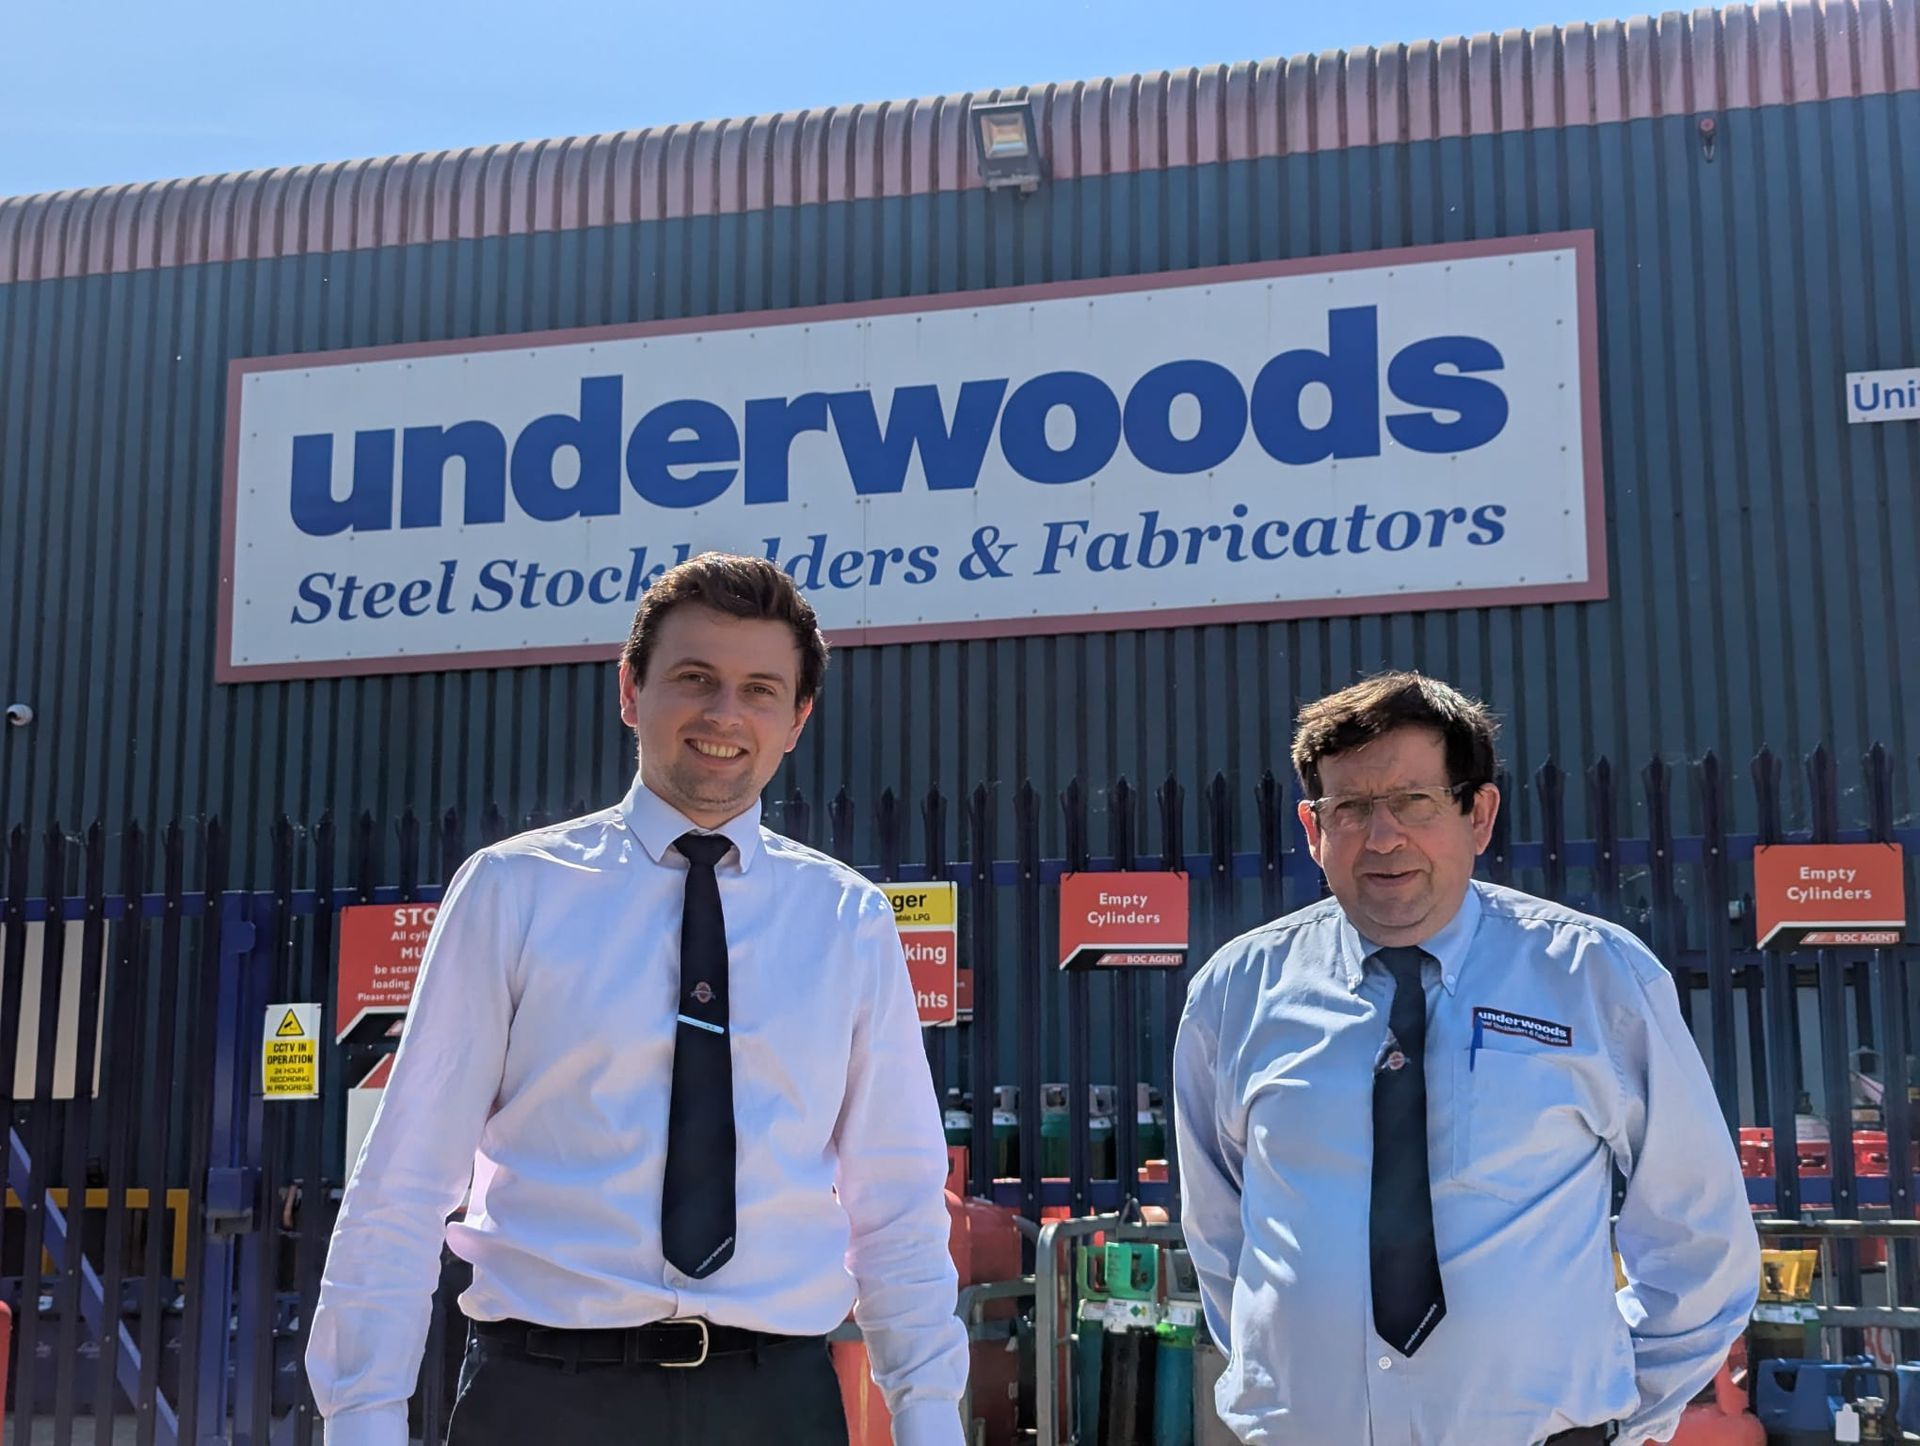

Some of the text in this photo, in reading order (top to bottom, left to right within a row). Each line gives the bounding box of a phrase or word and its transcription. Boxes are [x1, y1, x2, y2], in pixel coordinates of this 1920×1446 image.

[1853, 379, 1920, 411] Uni
[290, 304, 1510, 537] underwoods
[290, 503, 1507, 624] Steel Stockders & Fabricators
[1799, 866, 1856, 883] Empty
[1099, 892, 1148, 908] Empty
[1786, 887, 1872, 903] Cylinders
[888, 894, 928, 913] ger
[394, 907, 438, 927] STO
[913, 912, 930, 921] LPG
[1087, 911, 1161, 927] Cylinders
[391, 930, 428, 942] All cyli
[1835, 933, 1897, 942] BOC AGENT
[401, 946, 425, 959] MU
[905, 943, 947, 965] king
[1127, 955, 1180, 963] BOC AGENT
[374, 965, 418, 975] be scan
[372, 979, 410, 991] loading
[357, 993, 385, 1001] Please
[917, 990, 949, 1008] hts
[1478, 1010, 1567, 1038] underwoods
[273, 1042, 307, 1053] CCTV IN
[267, 1054, 313, 1065] OPERATION
[274, 1084, 313, 1092] PROGRESS
